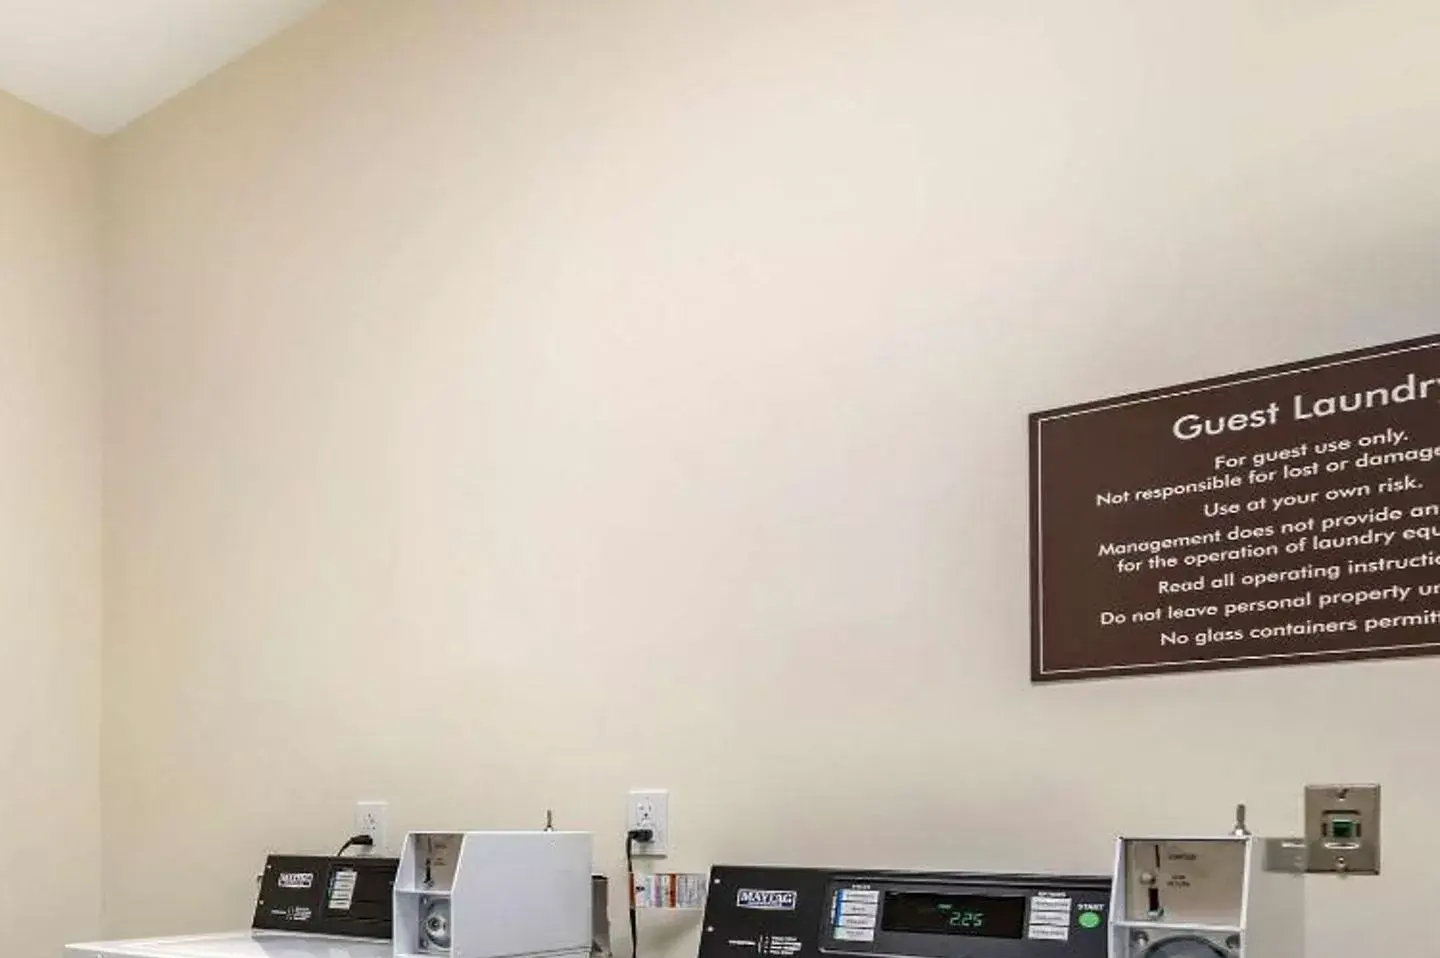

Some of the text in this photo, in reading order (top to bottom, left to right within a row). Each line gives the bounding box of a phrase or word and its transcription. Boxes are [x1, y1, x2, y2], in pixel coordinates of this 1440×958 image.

[1172, 373, 1440, 441] Guest Laundr
[1214, 427, 1410, 470] For guest use only.
[1096, 490, 1131, 507] Not
[1135, 474, 1243, 502] responsible
[1248, 469, 1278, 485] for
[1283, 462, 1319, 479] lost
[1326, 461, 1350, 473] or
[1203, 475, 1424, 518] Use at your own risk.
[1097, 504, 1439, 558] Management does not provide an
[1117, 558, 1144, 574] for
[1148, 553, 1178, 570] the
[1183, 543, 1279, 567] operation
[1285, 536, 1308, 554] of
[1312, 528, 1397, 550] laundry
[1158, 577, 1205, 594] Read
[1210, 572, 1236, 589] all
[1241, 563, 1341, 588] operating
[1100, 611, 1128, 626] Do
[1131, 608, 1162, 624] not
[1168, 605, 1218, 620] leave
[1224, 591, 1312, 618] personal
[1318, 584, 1412, 609] property
[1160, 631, 1190, 646] No
[1195, 627, 1244, 646] glass
[1249, 619, 1359, 640] containers
